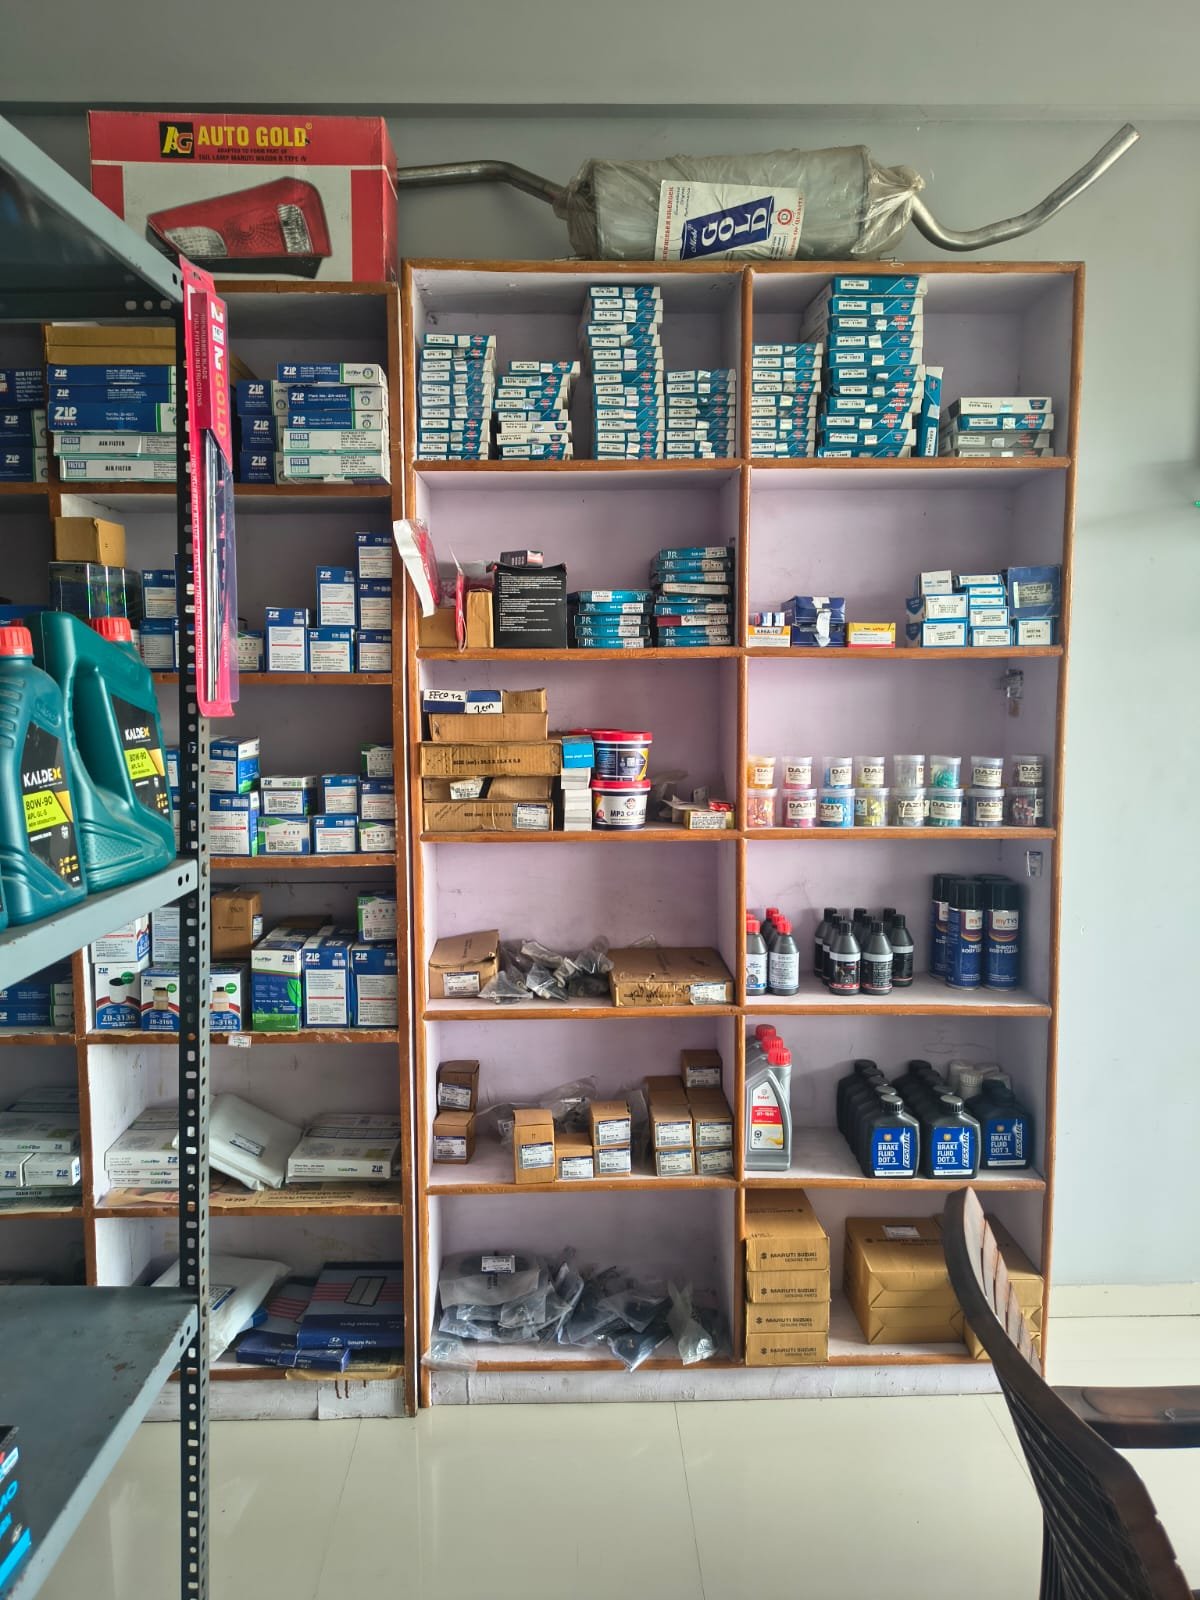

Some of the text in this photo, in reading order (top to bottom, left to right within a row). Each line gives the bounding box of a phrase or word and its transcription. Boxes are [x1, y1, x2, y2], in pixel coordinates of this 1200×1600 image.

[198, 126, 249, 146] AUTO
[256, 127, 307, 147] GOLD
[701, 208, 768, 246] GOLD
[54, 369, 68, 378] ZIP
[283, 366, 296, 375] ZIP
[56, 389, 70, 397] ZIP
[249, 384, 264, 394] ZIP
[292, 392, 304, 401] ZIP
[215, 373, 227, 438] GOLD
[55, 406, 78, 420] ZIP
[254, 420, 269, 430] ZIP
[293, 416, 305, 424] ZIP
[252, 456, 267, 466] ZIP
[125, 726, 150, 740] KALDEX
[23, 766, 62, 788] KALDEX
[26, 796, 53, 810] 80W-90
[306, 953, 320, 962] ZIP
